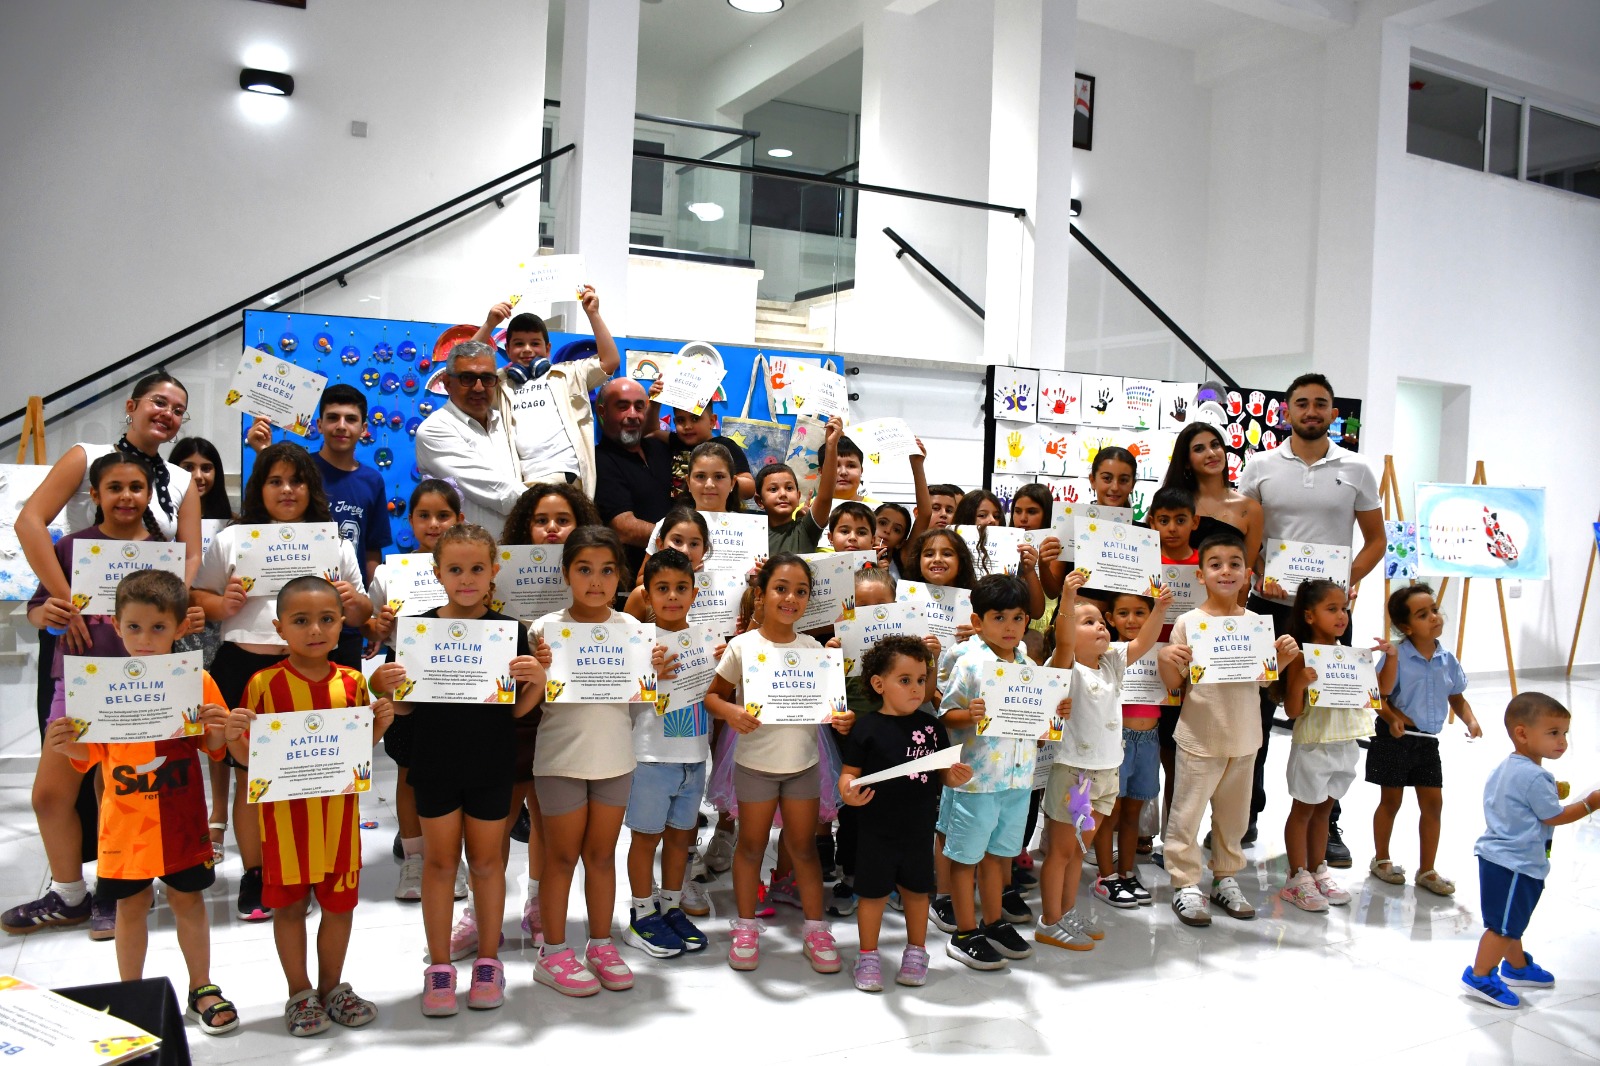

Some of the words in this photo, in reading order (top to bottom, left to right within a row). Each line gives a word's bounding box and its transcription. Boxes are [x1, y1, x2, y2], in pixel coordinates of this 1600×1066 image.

[262, 373, 296, 391] KATILIM
[256, 381, 294, 400] BELGESİ
[335, 500, 364, 518] Jersey
[712, 538, 744, 546] ELGESİ
[1103, 541, 1138, 553] KATILIM
[268, 543, 309, 552] KATILIM
[266, 553, 311, 563] BELGESİ
[1101, 551, 1139, 564] BELGESİ
[1291, 557, 1325, 565] KATILIM
[109, 562, 153, 570] KATILIM
[519, 565, 561, 574] KATILIM
[1288, 564, 1325, 573] BELGESİ
[516, 576, 562, 586] BELGESİ
[697, 590, 724, 598] ATILIM
[864, 622, 902, 633] KATILIM
[1214, 634, 1250, 643] KATILIM
[434, 642, 482, 652] KATILIM
[579, 645, 623, 654] KATILIM
[1213, 644, 1252, 653] BELGESİ
[431, 654, 483, 665] BELGESİ
[576, 657, 625, 666] BELGESİ
[1326, 663, 1356, 671] KATILIM
[774, 670, 814, 678] KATILIM
[1325, 672, 1358, 680] BELGESİ
[109, 680, 164, 692] KATILIM
[772, 681, 816, 690] BELGESİ
[1008, 685, 1043, 696] KATILIM
[105, 692, 166, 705] BELGESİ
[1004, 696, 1042, 706] BELGESİ
[290, 735, 339, 747] KATILIM
[286, 747, 340, 761] BELGESİ
